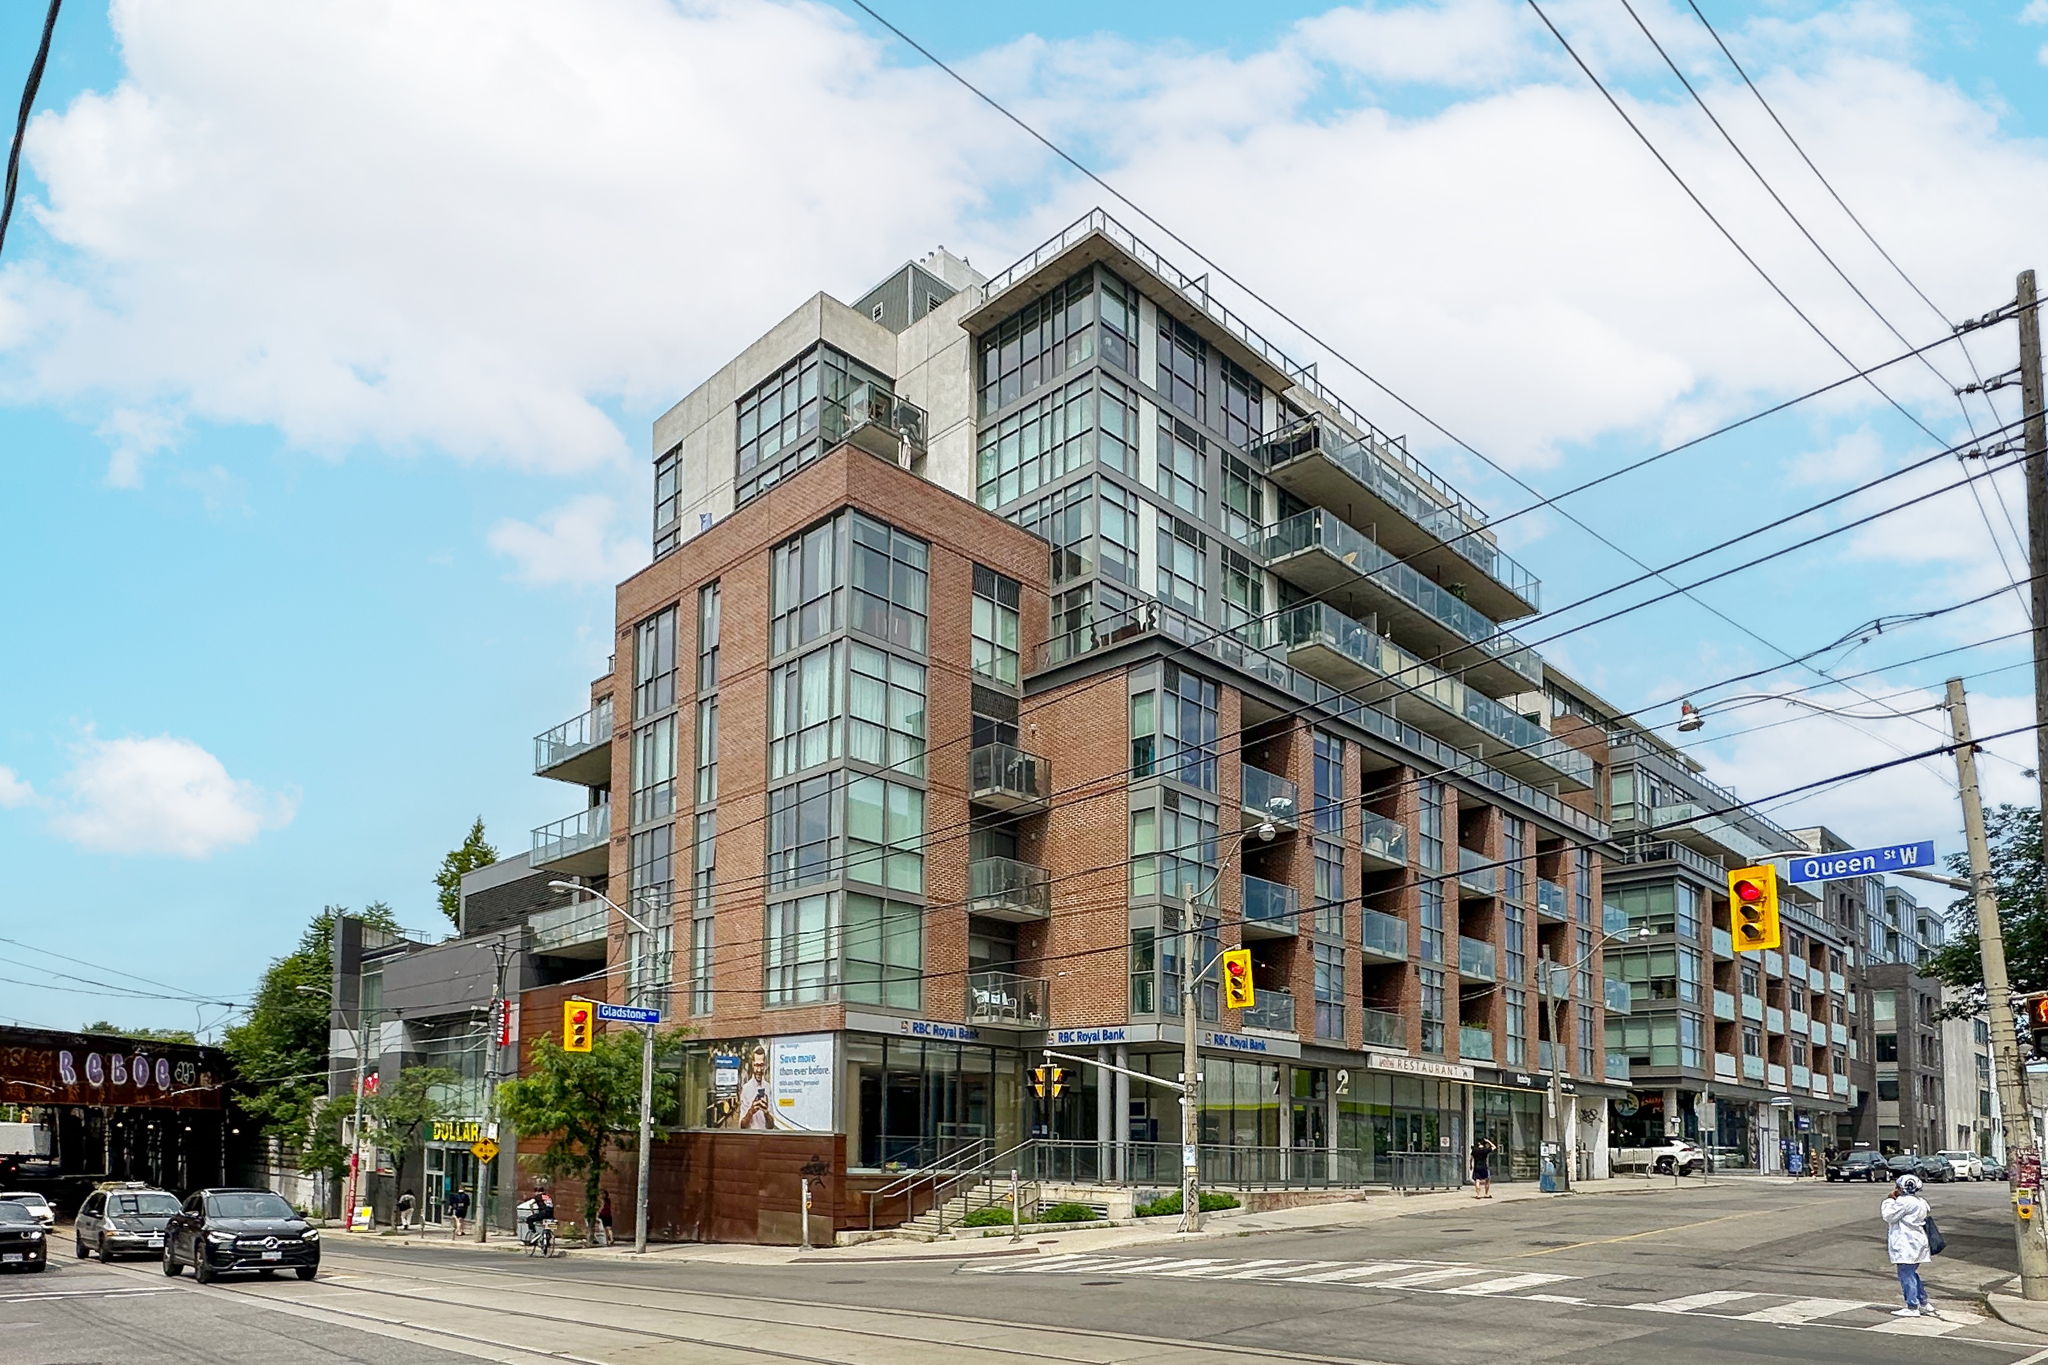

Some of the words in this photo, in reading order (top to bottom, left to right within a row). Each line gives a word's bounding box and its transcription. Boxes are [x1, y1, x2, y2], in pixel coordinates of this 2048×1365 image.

[1804, 855, 1876, 879] Queen
[1883, 849, 1896, 860] St
[1900, 846, 1918, 866] W
[601, 1006, 647, 1020] Gladstone
[912, 1021, 931, 1035] RBC
[932, 1024, 957, 1039] Royal
[958, 1027, 979, 1040] Bank
[1058, 1031, 1075, 1043] RBC
[1076, 1029, 1100, 1044] Royal
[1102, 1028, 1125, 1041] Bank
[1213, 1033, 1229, 1046] RBC
[1229, 1036, 1249, 1050] Royal
[1249, 1038, 1267, 1051] Bank
[779, 1054, 797, 1064] Save
[797, 1054, 816, 1063] more
[793, 1067, 808, 1076] ever
[1397, 1060, 1458, 1077] RESTAURANT
[1335, 1069, 1349, 1095] 2
[433, 1121, 499, 1142] DOLLAR
